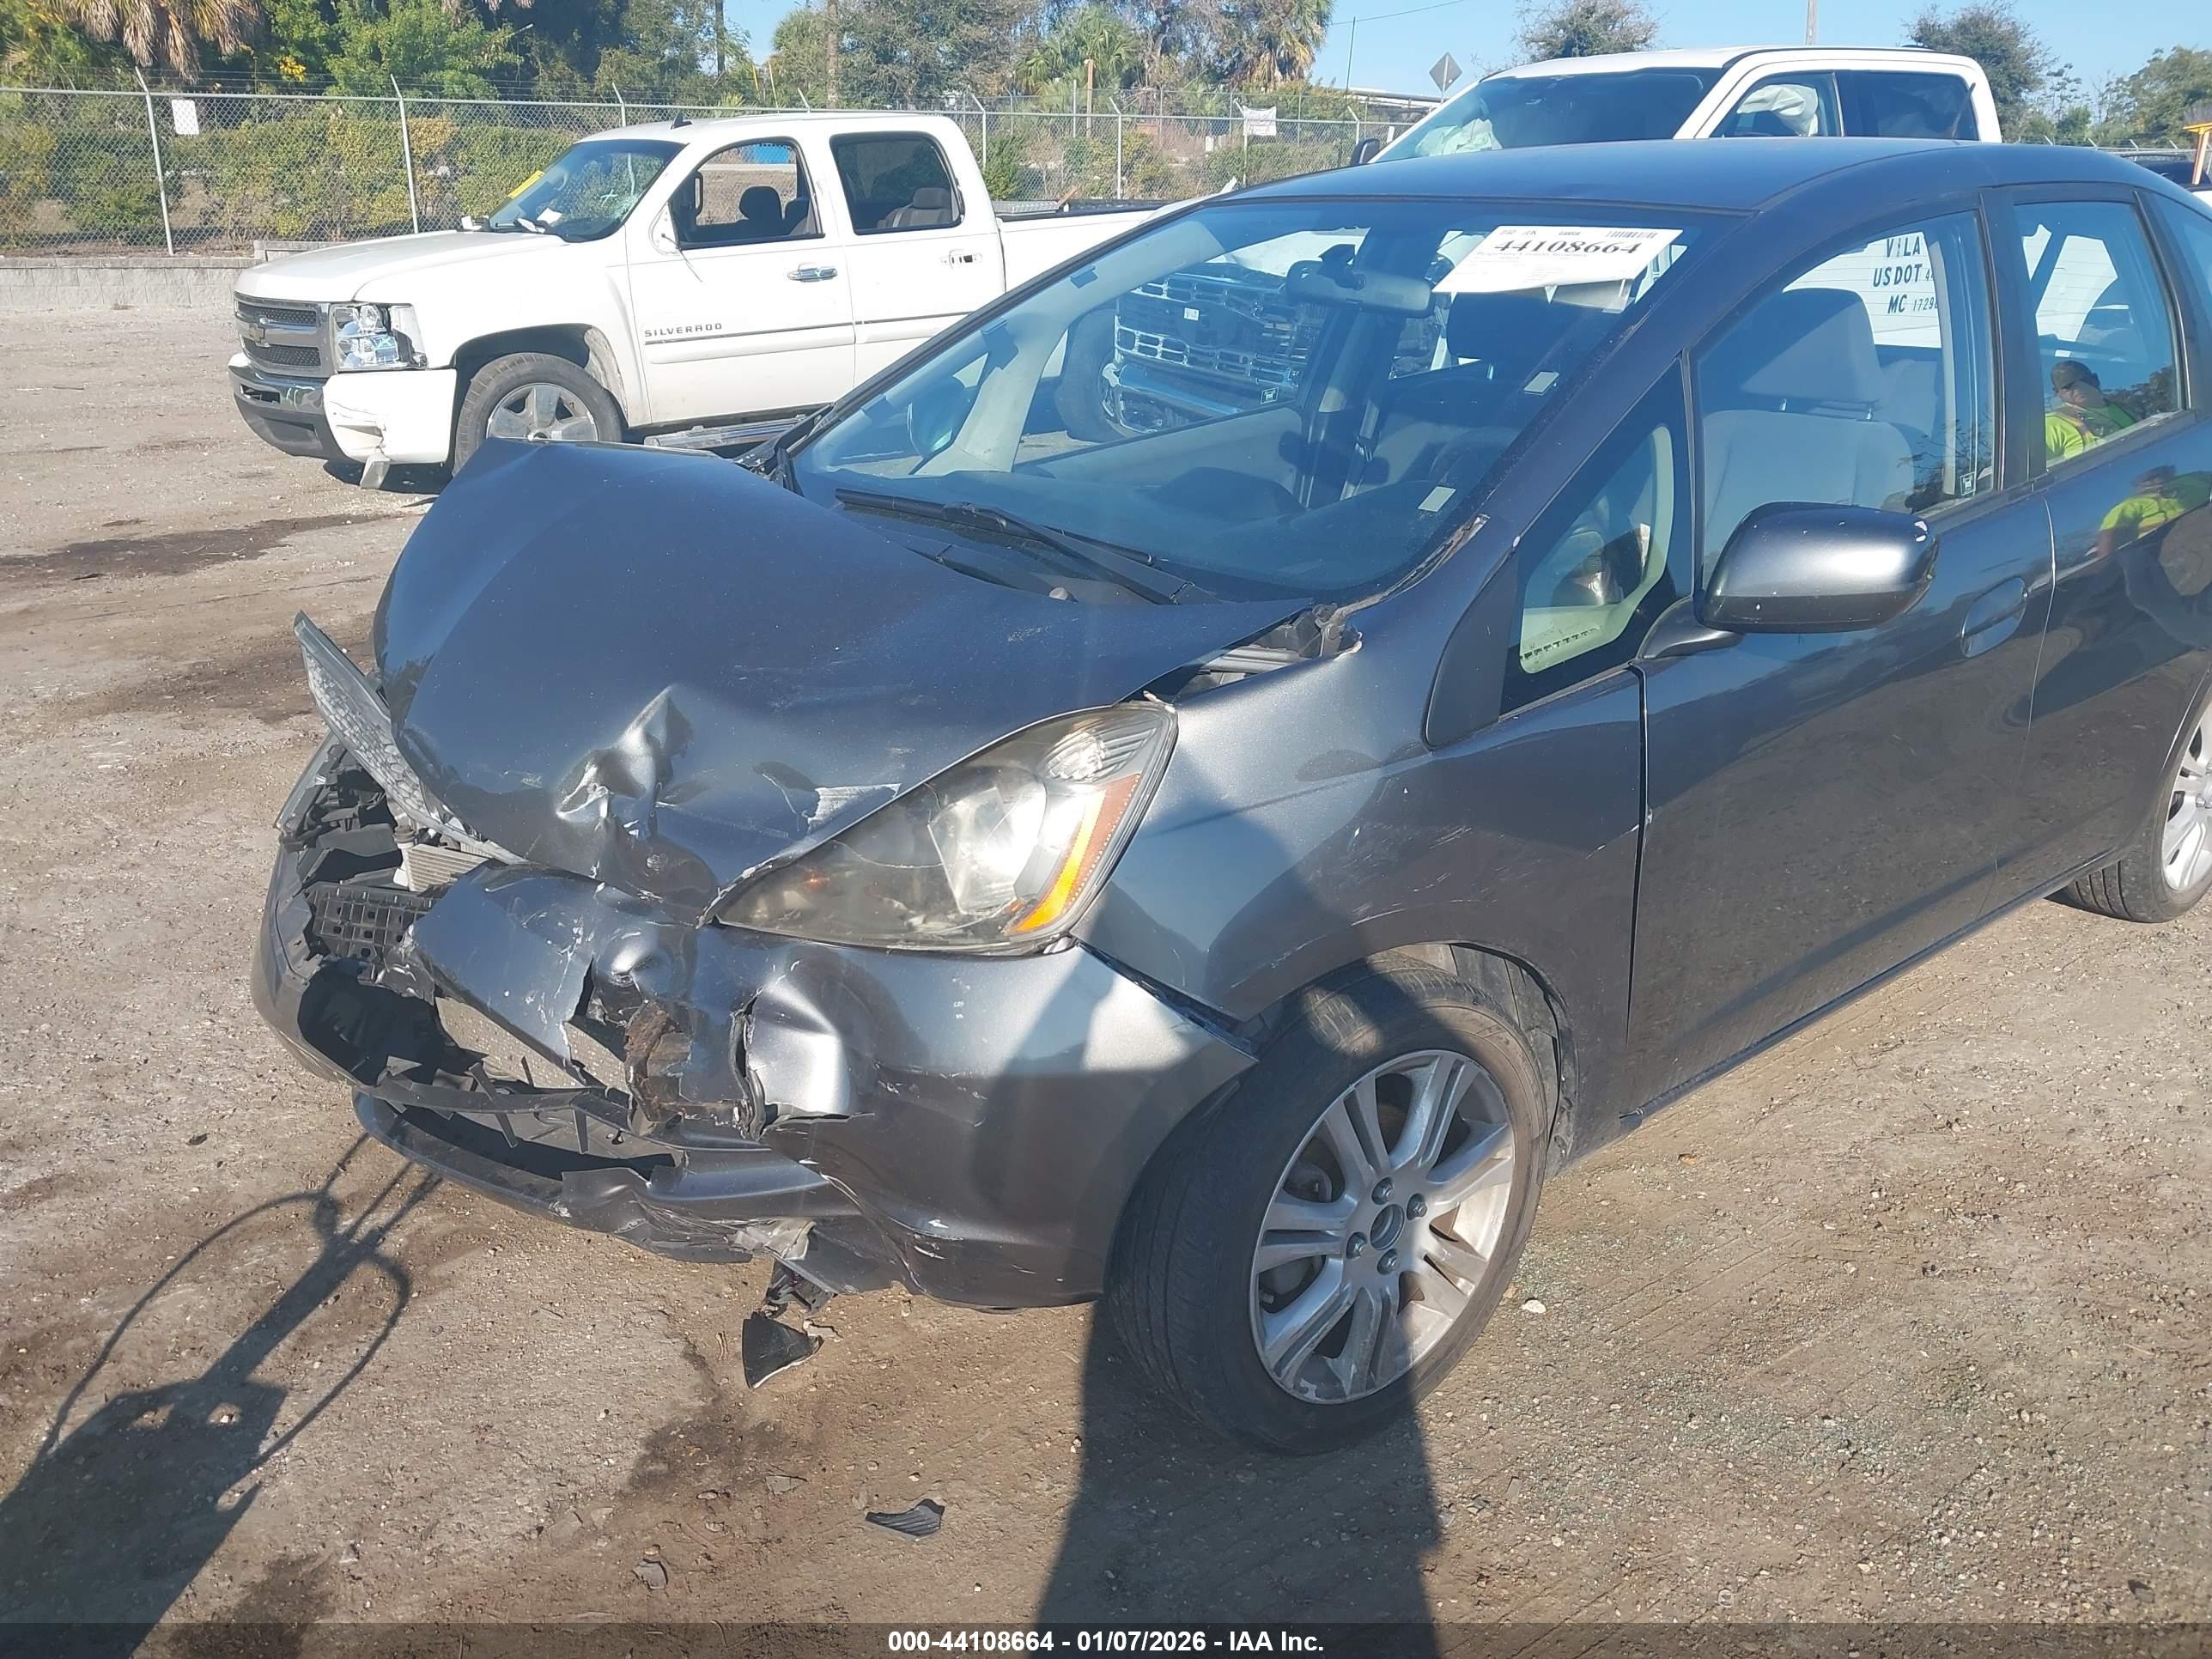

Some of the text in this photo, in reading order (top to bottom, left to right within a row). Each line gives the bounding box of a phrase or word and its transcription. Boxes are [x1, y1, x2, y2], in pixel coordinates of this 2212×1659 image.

[1494, 240, 1642, 254] 44108664
[1887, 294, 1907, 314] MC
[644, 323, 722, 337] SILVERADO
